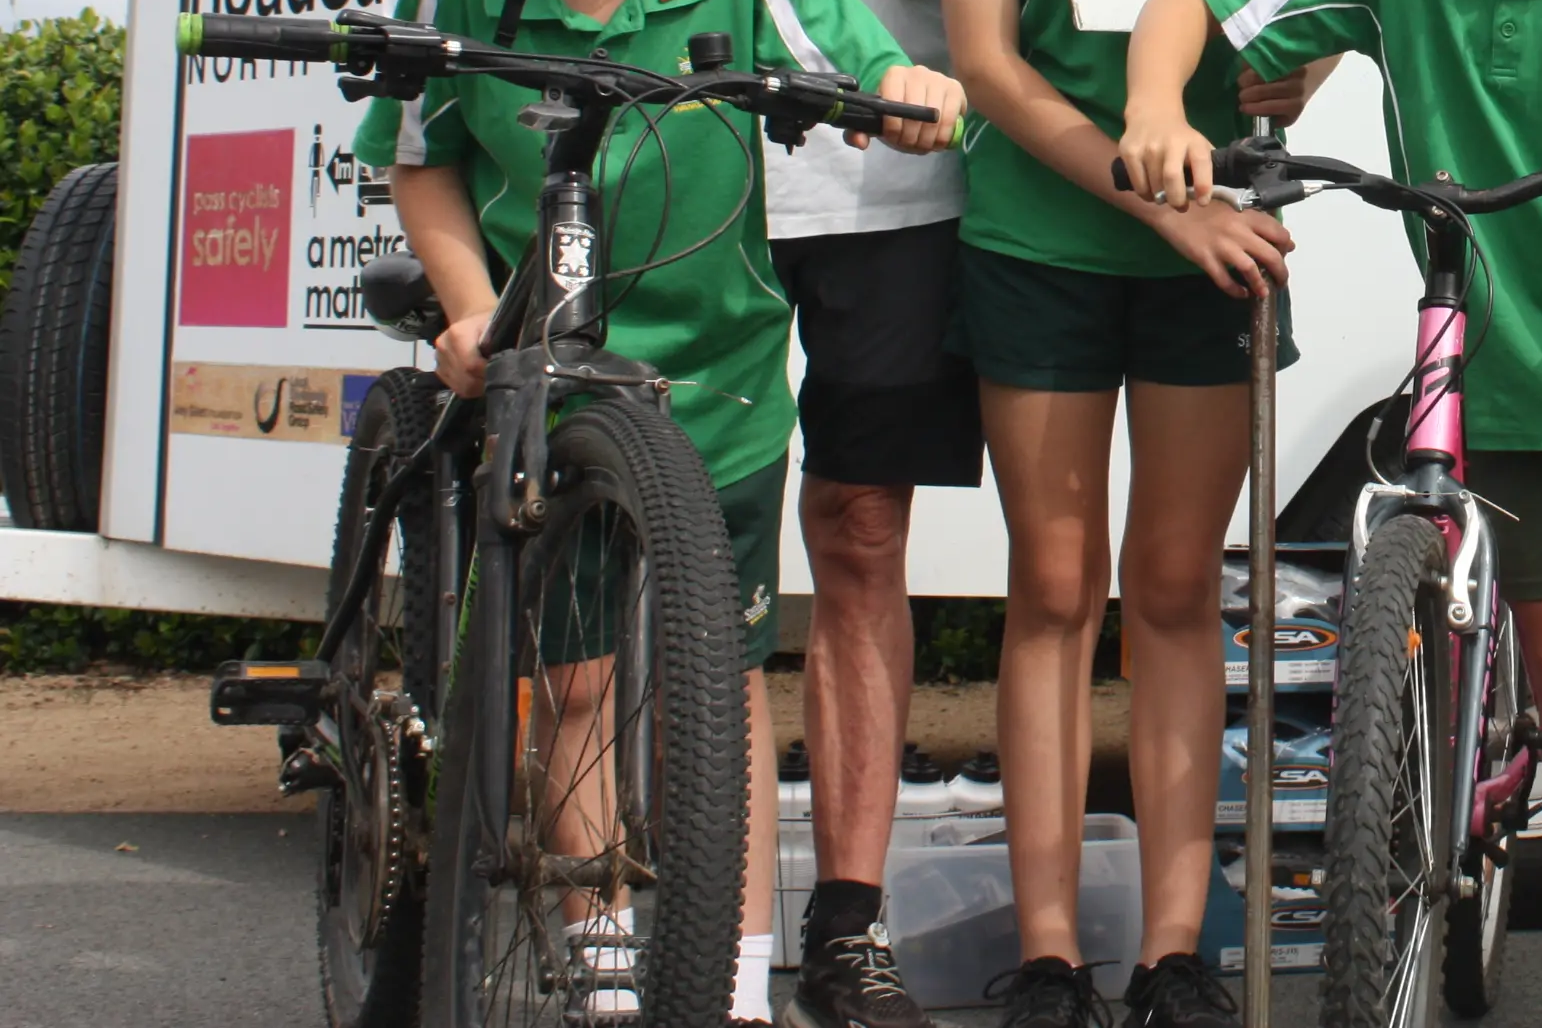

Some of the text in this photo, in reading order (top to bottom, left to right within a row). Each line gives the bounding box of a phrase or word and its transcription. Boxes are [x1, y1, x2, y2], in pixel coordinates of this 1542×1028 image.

[193, 183, 280, 215] pass cyclists
[193, 215, 279, 272] safely
[308, 236, 324, 268] a
